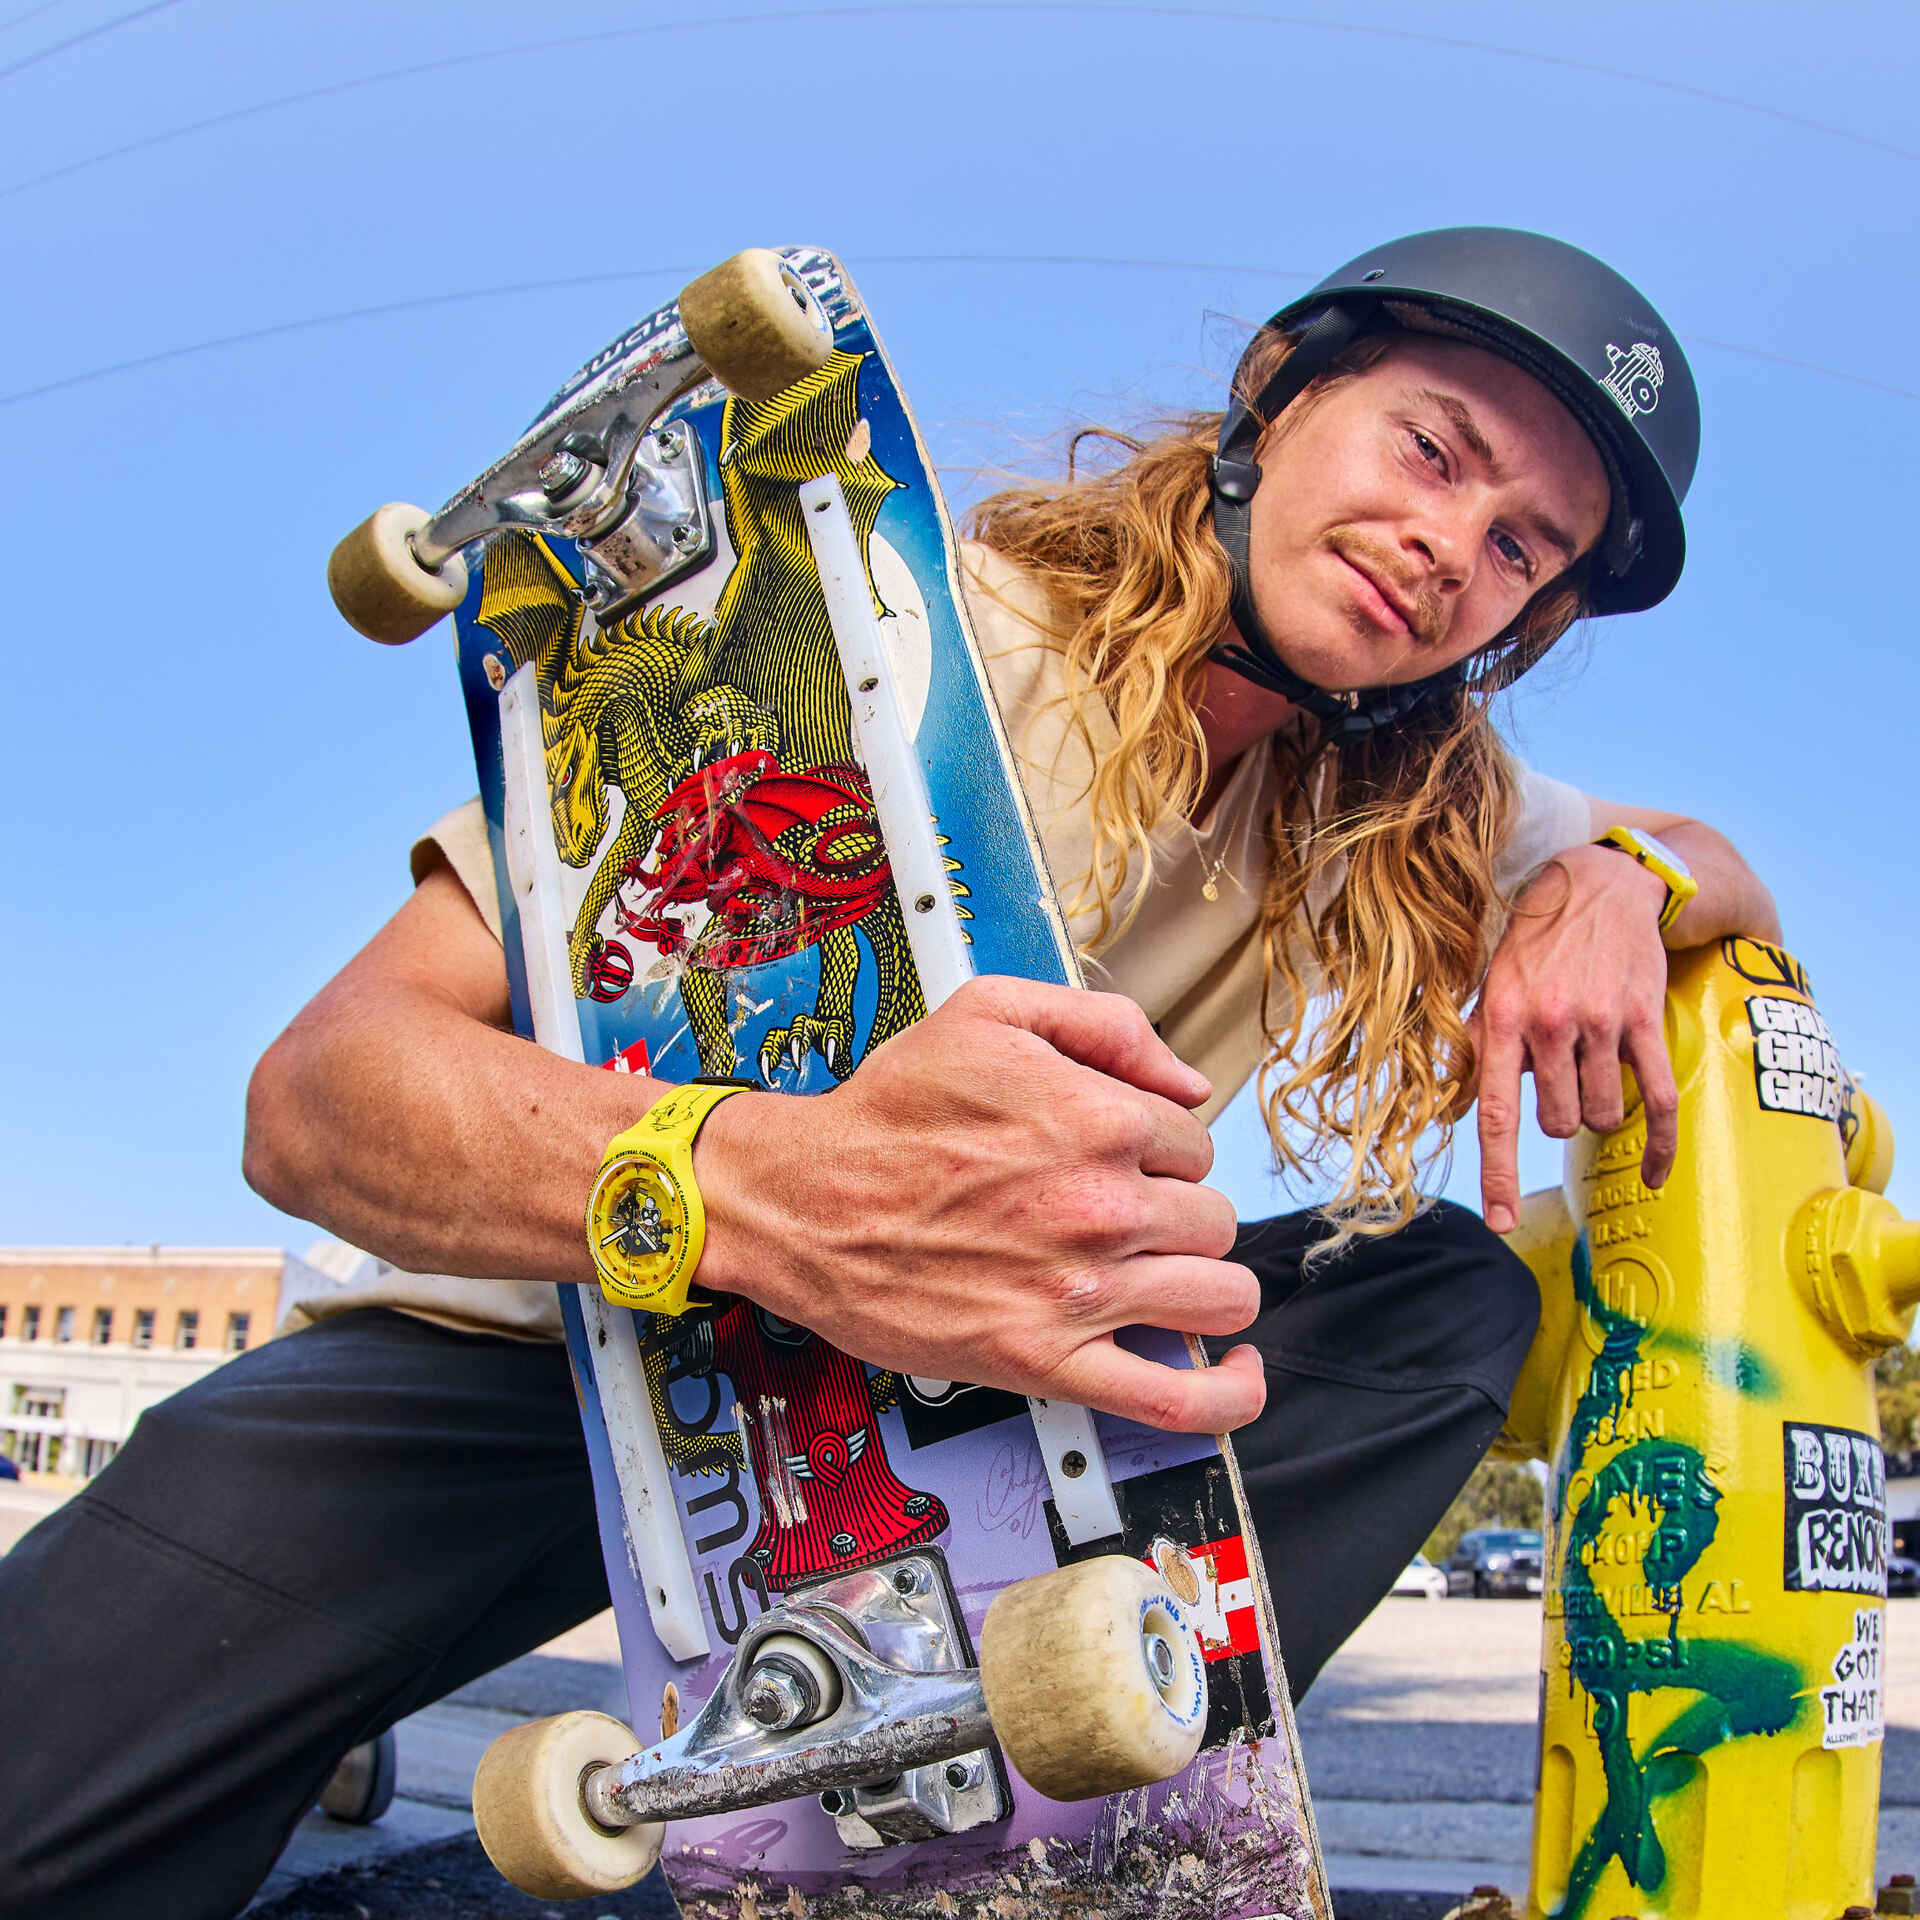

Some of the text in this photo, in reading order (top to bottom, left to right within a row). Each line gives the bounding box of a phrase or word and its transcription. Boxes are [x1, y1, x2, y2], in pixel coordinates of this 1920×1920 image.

[1696, 1580, 1752, 1615] AL
[1856, 1612, 1880, 1643] WE
[1834, 1648, 1879, 1682] GOT
[1823, 1688, 1878, 1725] THAT
